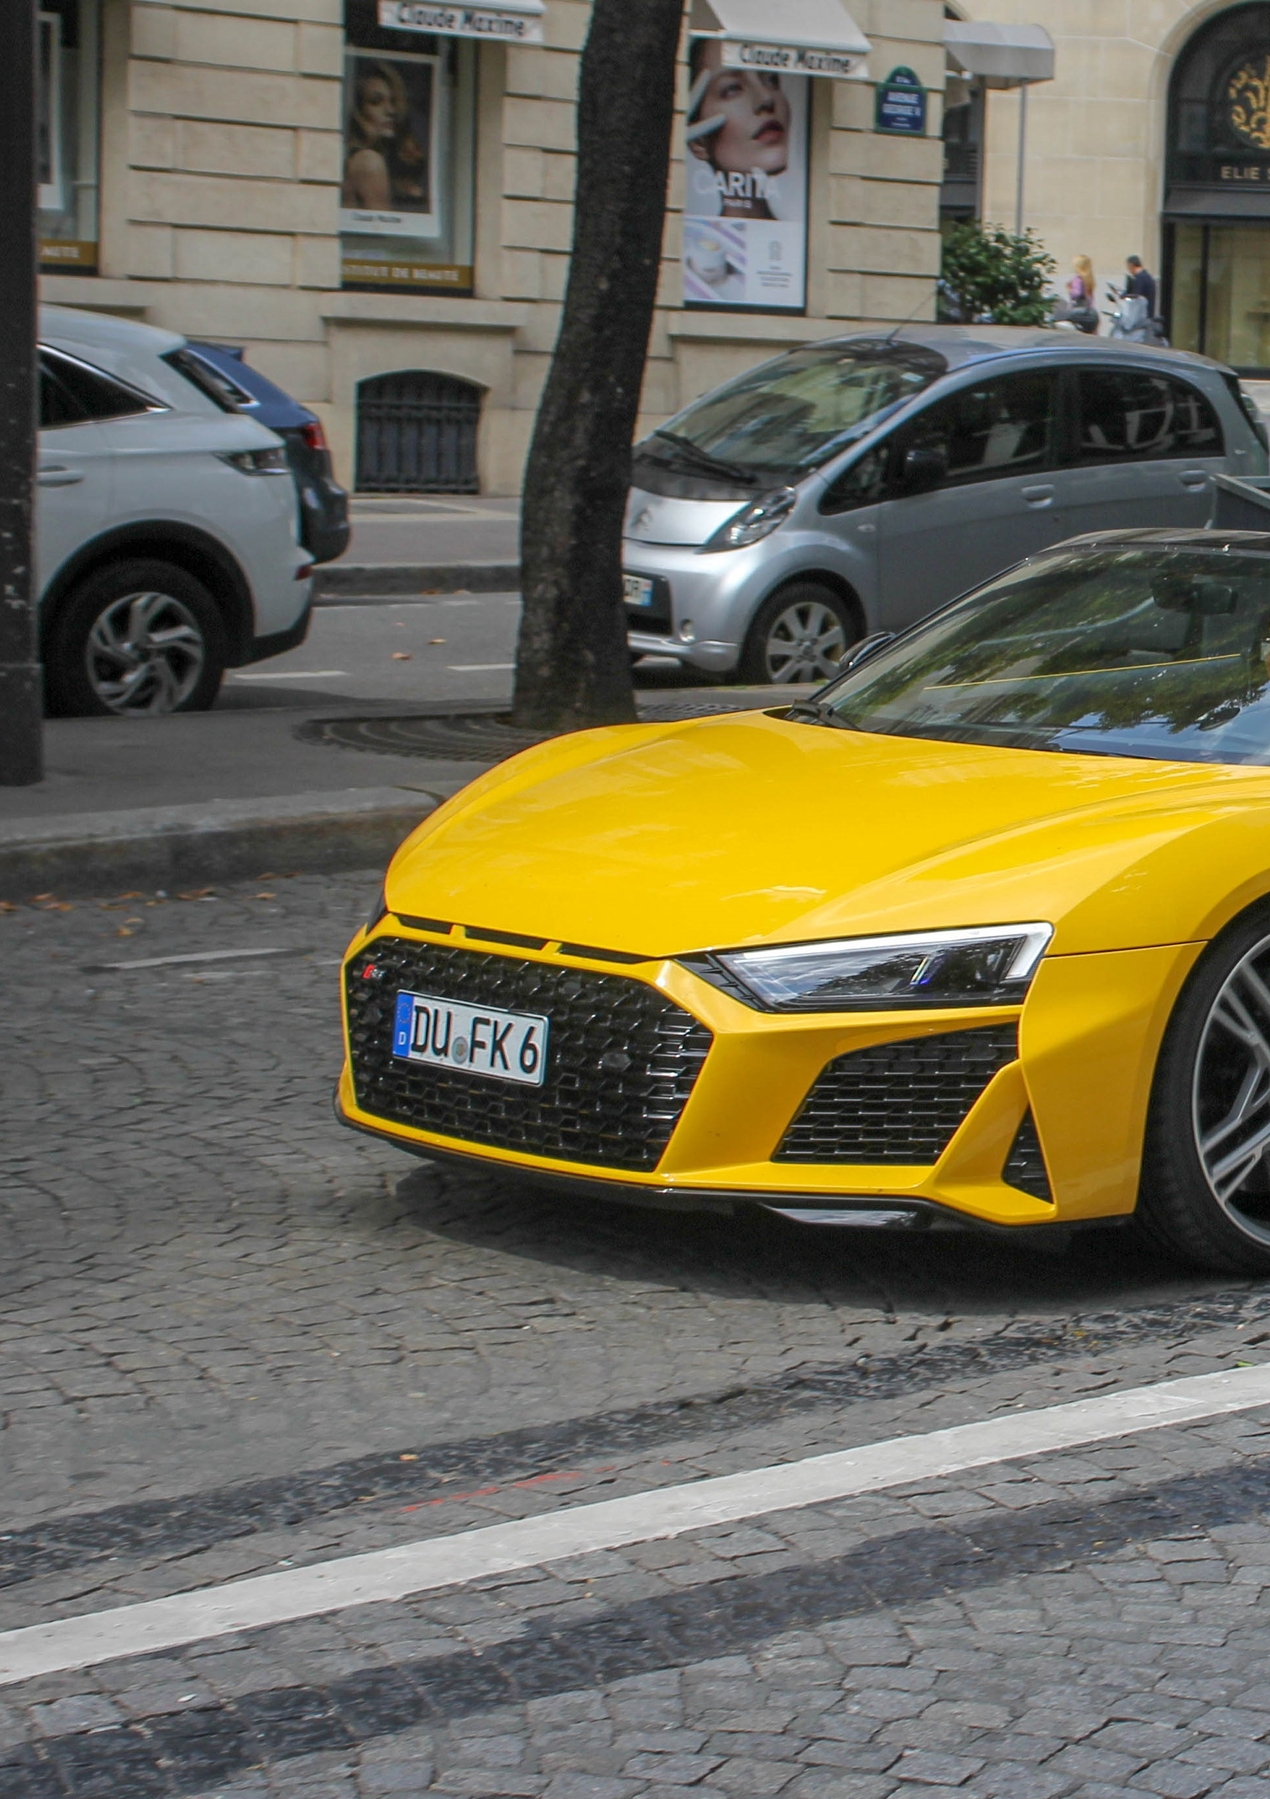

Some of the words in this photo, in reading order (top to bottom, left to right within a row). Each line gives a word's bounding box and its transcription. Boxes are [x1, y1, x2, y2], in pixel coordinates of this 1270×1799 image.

[398, 2, 455, 28] Claude
[462, 10, 525, 36] Maxime
[741, 42, 789, 67] Claude
[794, 49, 849, 73] Maxime
[693, 166, 782, 199] CARITA
[1221, 165, 1260, 179] ELIE
[399, 1031, 407, 1046] D
[411, 1005, 453, 1058] DU
[469, 1016, 515, 1071] FK
[519, 1025, 539, 1075] 6
